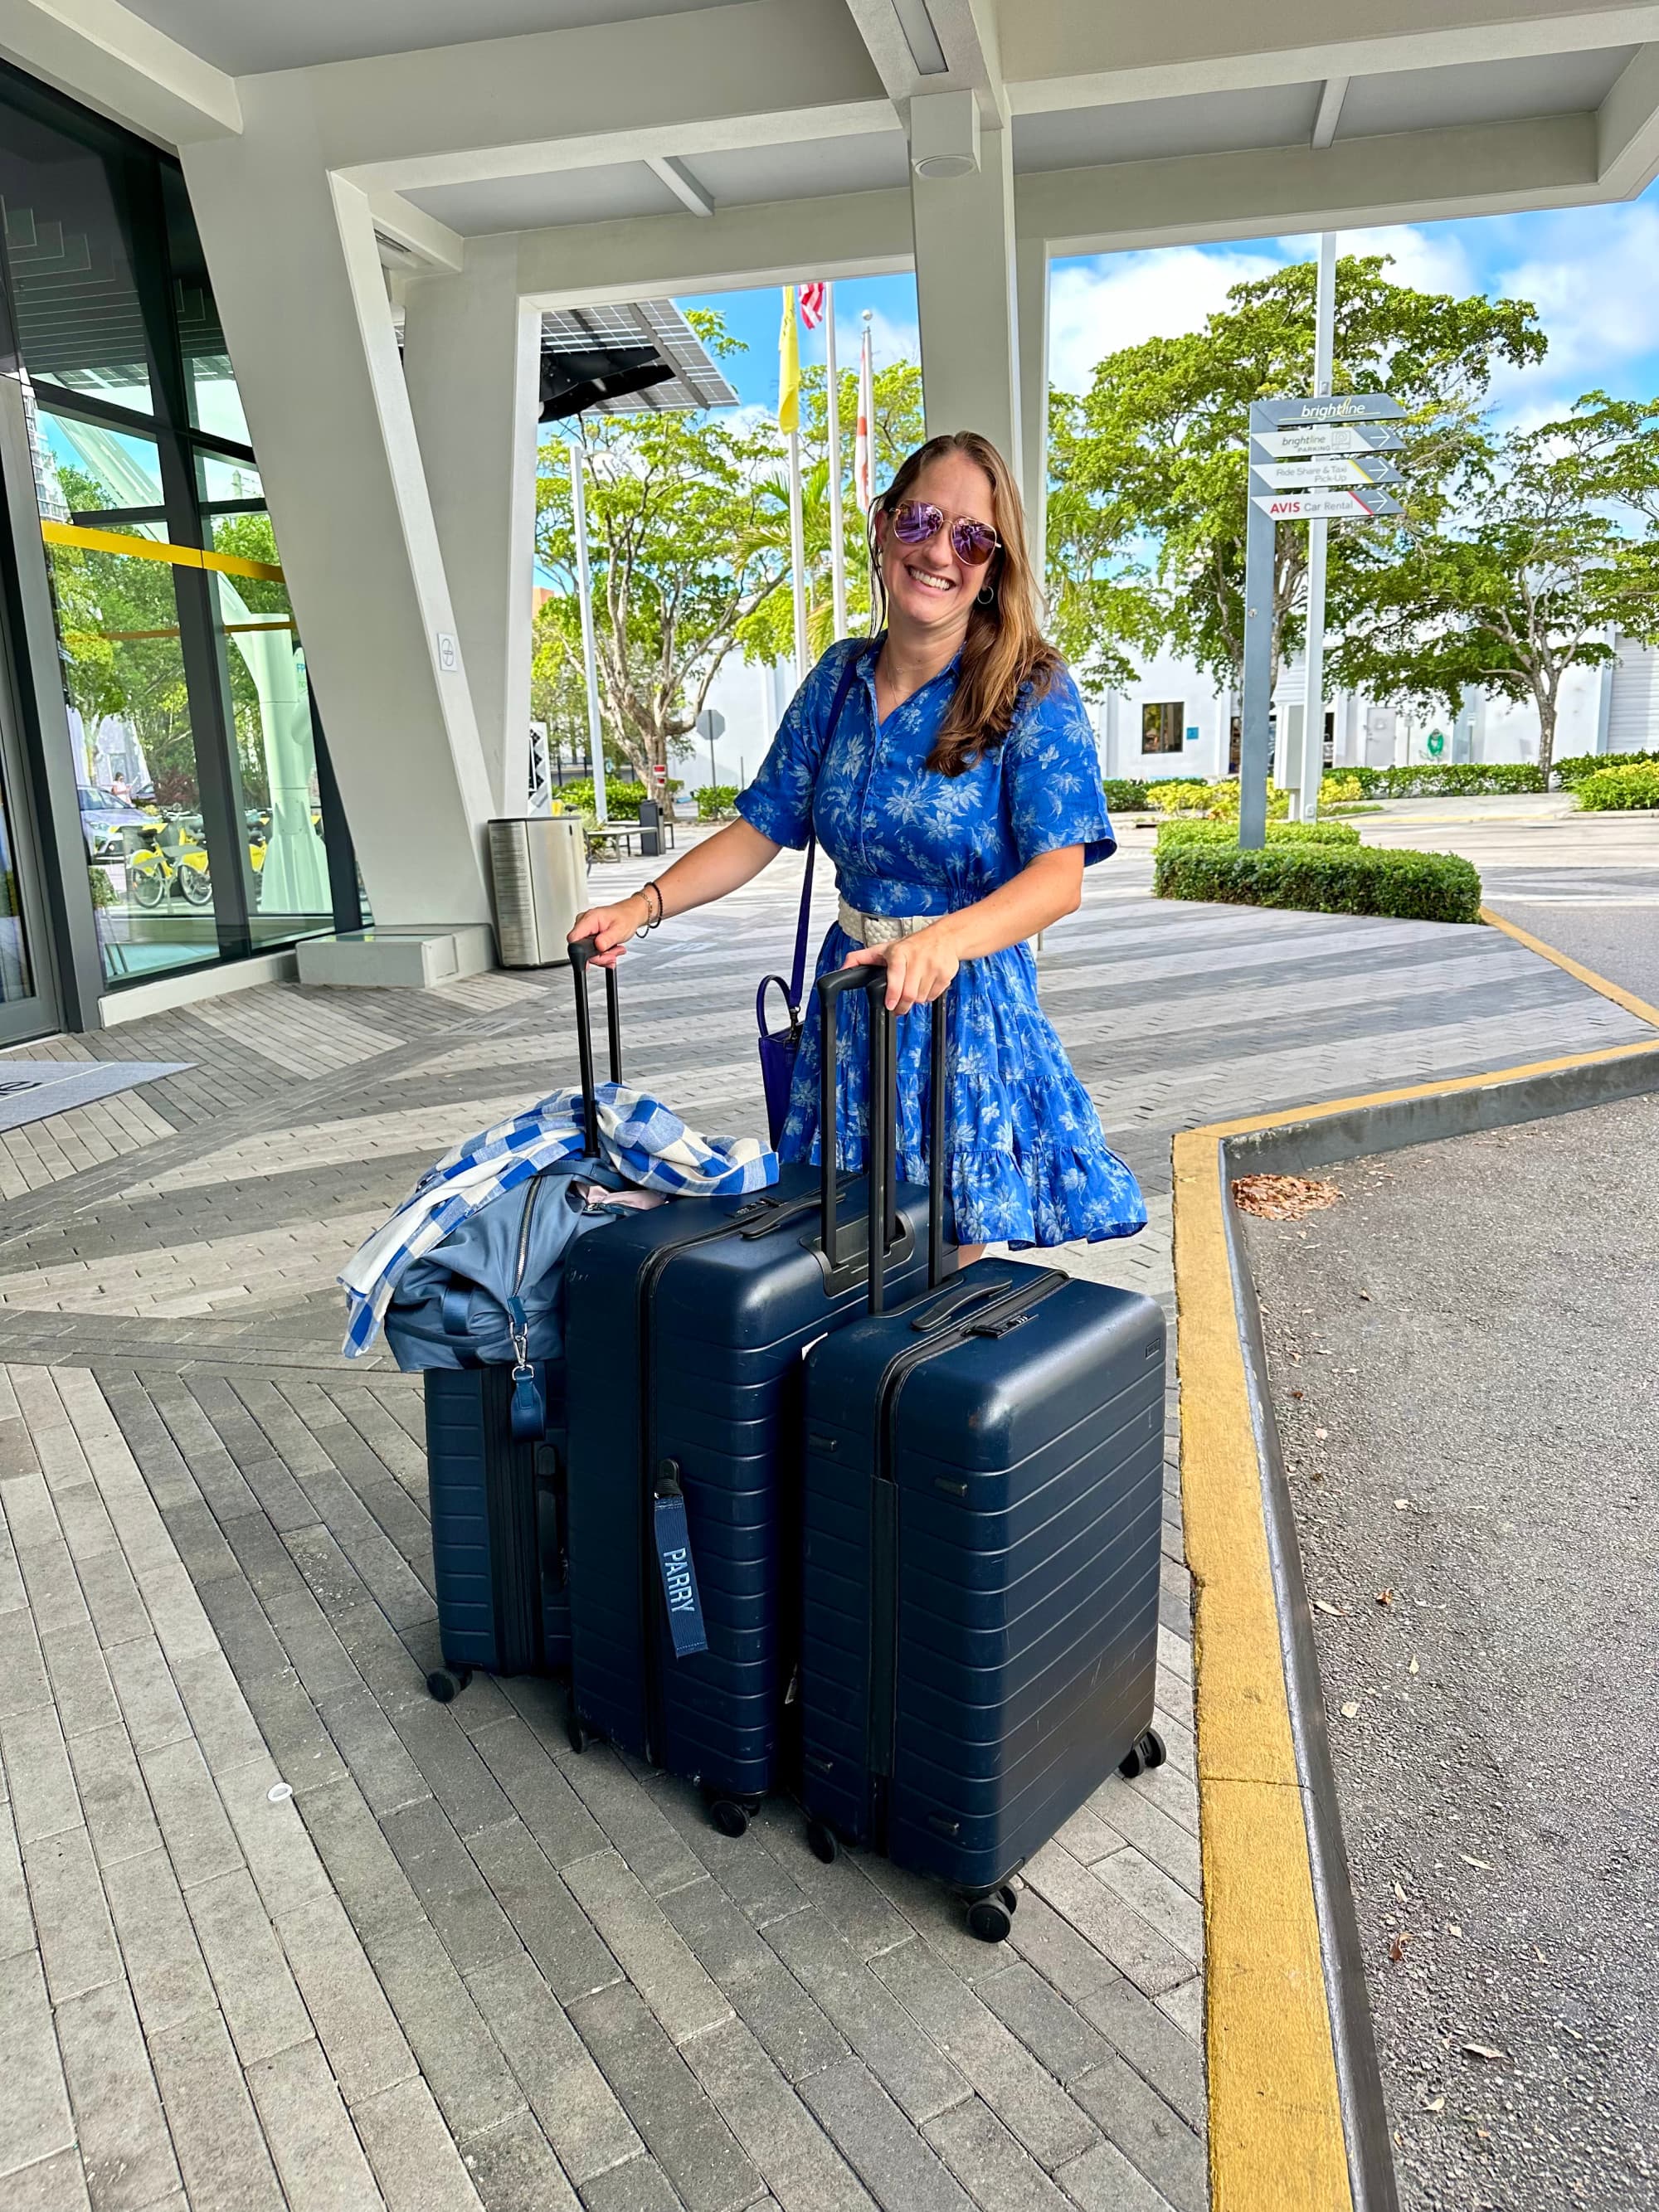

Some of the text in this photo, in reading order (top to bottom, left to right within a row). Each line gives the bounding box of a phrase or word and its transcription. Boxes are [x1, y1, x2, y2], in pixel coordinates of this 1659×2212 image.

[1301, 398, 1365, 421] brightline
[1282, 435, 1326, 448] brightline
[1297, 467, 1321, 475] Share
[1331, 465, 1347, 474] Taxi
[1314, 474, 1347, 483] Pick-Up
[1270, 501, 1353, 513] AVIS Car Rental
[664, 1548, 695, 1612] PARRY
